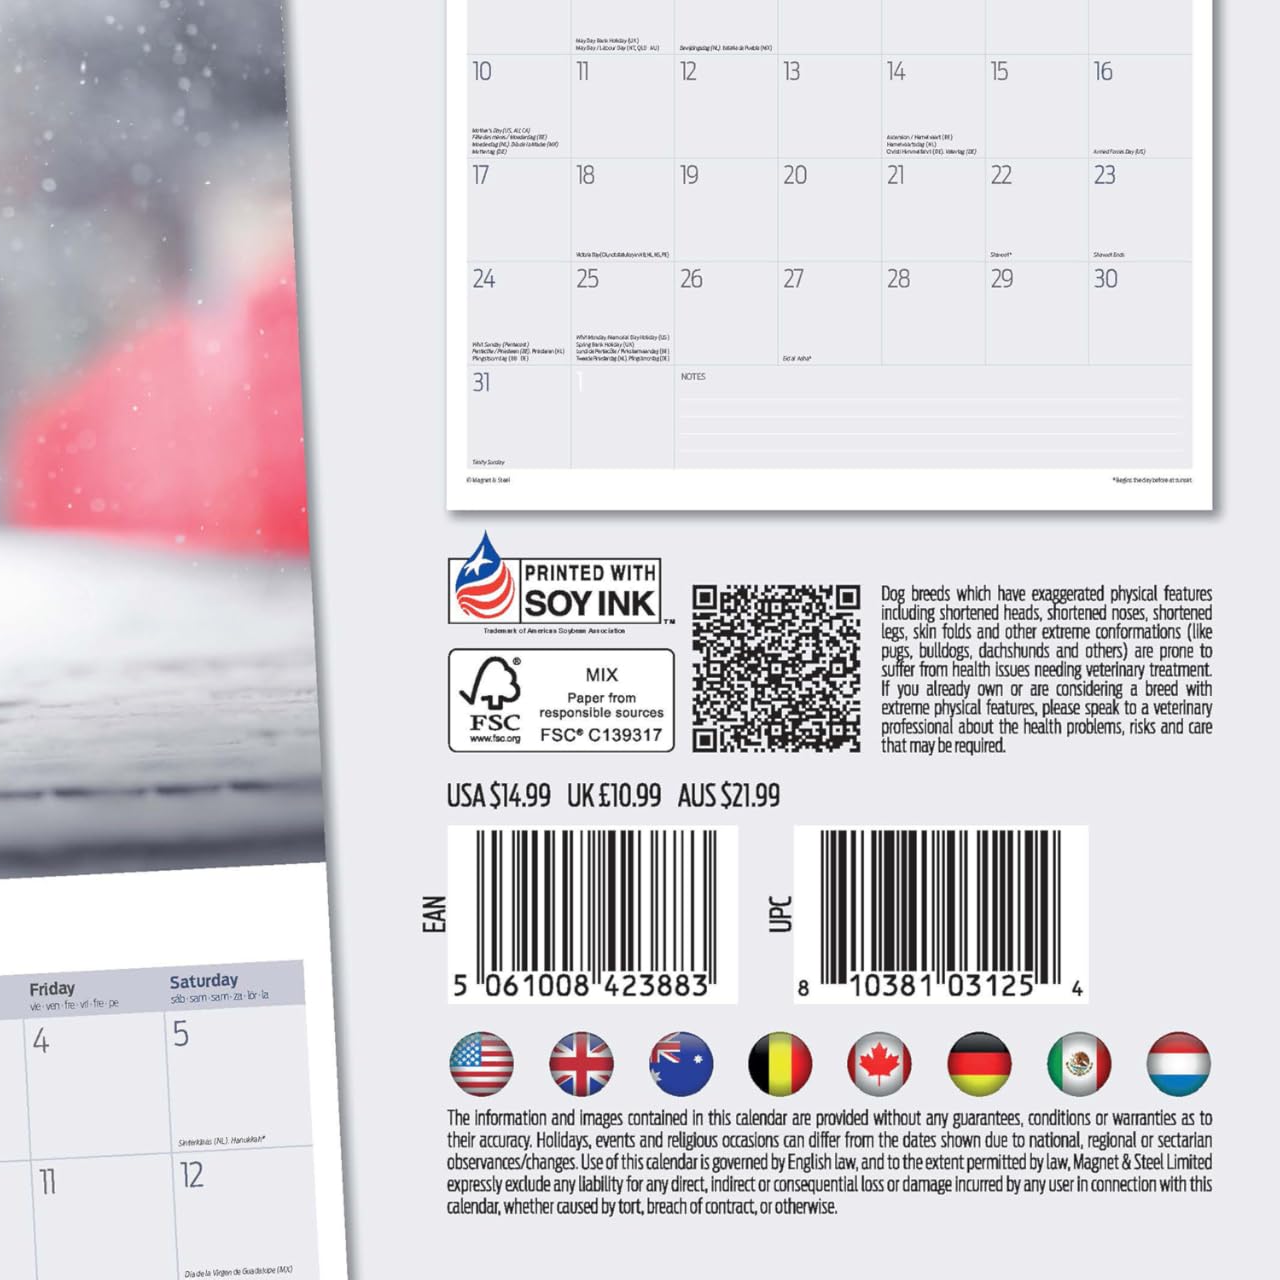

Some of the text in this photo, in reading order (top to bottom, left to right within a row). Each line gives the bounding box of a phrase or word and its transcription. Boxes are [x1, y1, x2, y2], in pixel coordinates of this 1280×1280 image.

[473, 165, 1115, 184] 17 18 19 20 21 22 23
[526, 565, 655, 581] PRINTED WITH
[525, 590, 655, 616] SOY INK
[882, 585, 1212, 603] Dog breeds which have exaggerated physical features
[882, 604, 1212, 623] including shortened heads, shortened noses, shortened
[587, 668, 618, 681] MIX
[568, 692, 636, 703] Paper from
[540, 704, 664, 719] responsible sources
[470, 714, 520, 731] FSC
[470, 734, 521, 744] www.fsc.org
[589, 728, 662, 742] C139317
[448, 781, 779, 809] USA $14.99 UK £10.99 AUS $21.99
[423, 897, 446, 932] EAN
[769, 896, 792, 932] UPC
[30, 981, 75, 997] Friday
[170, 973, 238, 989] Saturday
[454, 974, 707, 996] 5 061008 423883
[798, 975, 1083, 996] 8 10381 03125 4
[33, 1027, 49, 1053] 4
[174, 1020, 188, 1046] 5
[447, 1109, 1213, 1129] The information and images contained in this calendar are provided without any guarantees, conditions or warranties as to
[39, 1168, 55, 1194] 11
[180, 1161, 204, 1188] 12
